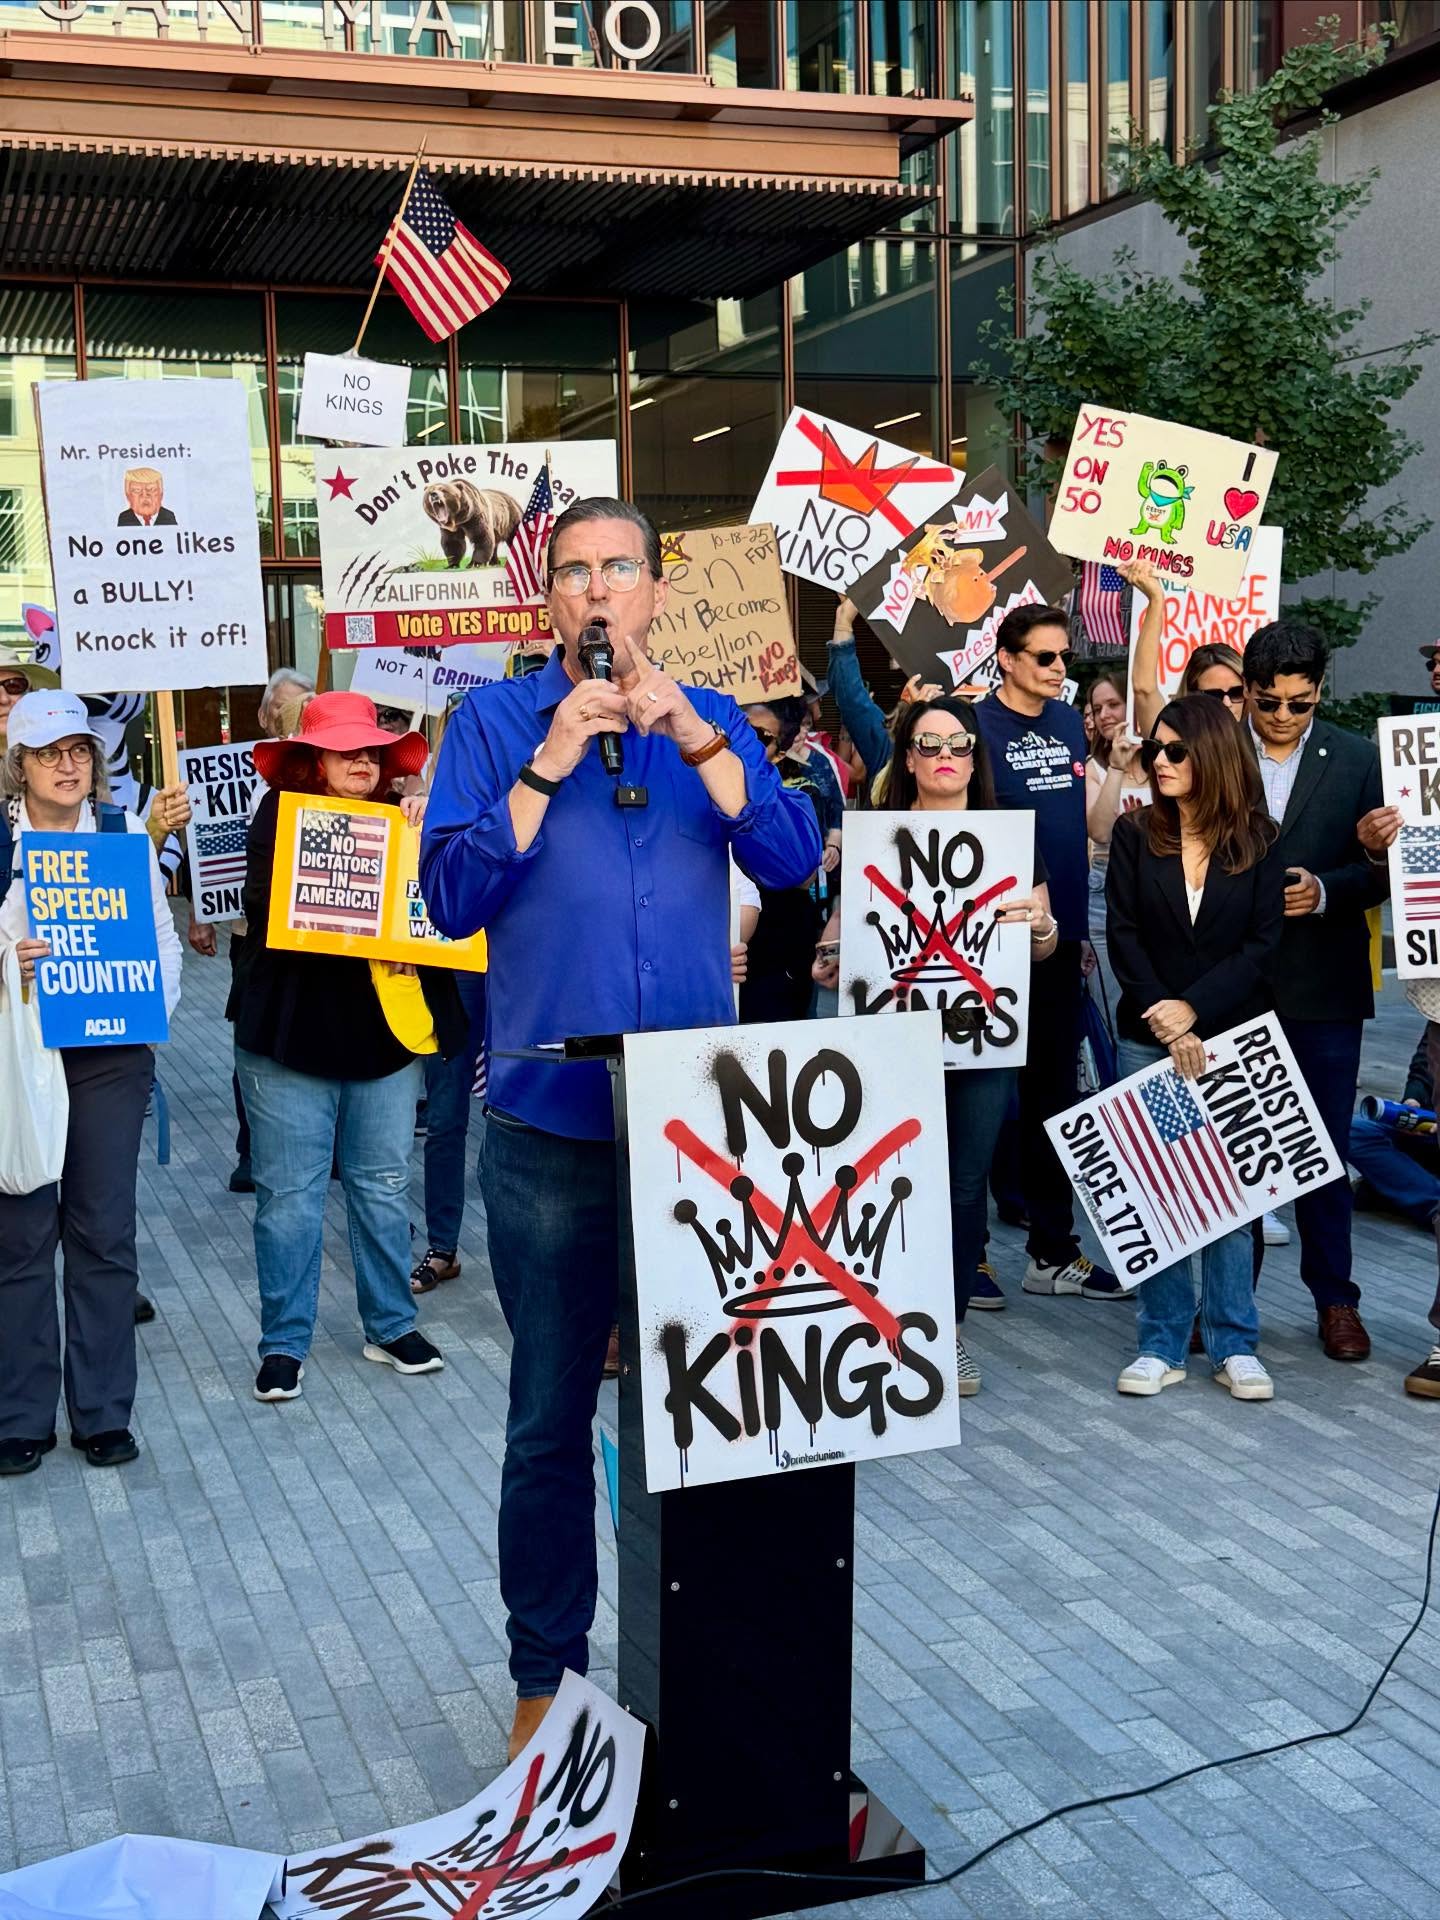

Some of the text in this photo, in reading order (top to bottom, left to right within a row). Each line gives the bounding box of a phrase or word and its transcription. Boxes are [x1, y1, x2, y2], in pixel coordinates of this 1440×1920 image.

[343, 373, 371, 391] NO
[326, 393, 383, 415] KINGS
[60, 443, 192, 460] Mr. President:
[1077, 412, 1257, 482] YES I
[1073, 456, 1110, 486] ON
[354, 469, 417, 526] Don't
[417, 452, 477, 484] Poke
[487, 450, 529, 480] The
[1060, 486, 1102, 515] 50
[798, 498, 871, 552] NO
[964, 508, 1000, 530] MY
[68, 531, 236, 557] No one likes
[1205, 520, 1253, 552] USA
[744, 540, 775, 565] FDT
[1103, 536, 1194, 578] NO KINGS
[376, 581, 480, 603] CALIFORNIA
[668, 558, 744, 594] en
[73, 580, 194, 605] a BULLY!
[1139, 574, 1268, 639] RANGE
[396, 608, 551, 638] Vote YES Prop 5
[693, 598, 782, 633] Becomes
[76, 623, 248, 652] Knock it off!
[375, 658, 408, 675] NOT
[413, 668, 424, 680] A
[758, 641, 784, 673] NO
[1005, 746, 1072, 763] CALIFORNIA
[1391, 724, 1440, 767] RE
[185, 750, 257, 785] RESIS
[206, 778, 257, 818] KIN
[329, 834, 356, 855] NO
[895, 827, 985, 889] NO
[27, 850, 90, 884] FREE
[300, 850, 380, 875] DICTATORS
[331, 870, 349, 890] IN
[30, 886, 128, 921] SPEECH
[201, 886, 246, 917] SIN
[297, 884, 379, 911] AMERICA!
[35, 924, 100, 957] FREE
[1406, 928, 1440, 967] SI
[40, 959, 157, 995] COUNTRY
[84, 1017, 126, 1037] ACLU
[713, 1048, 863, 1158] NO
[1232, 1024, 1330, 1187] RESISTING
[1196, 1060, 1285, 1188] KINGS
[1059, 1111, 1160, 1275] SINCE 1776
[537, 1705, 617, 1828] NO
